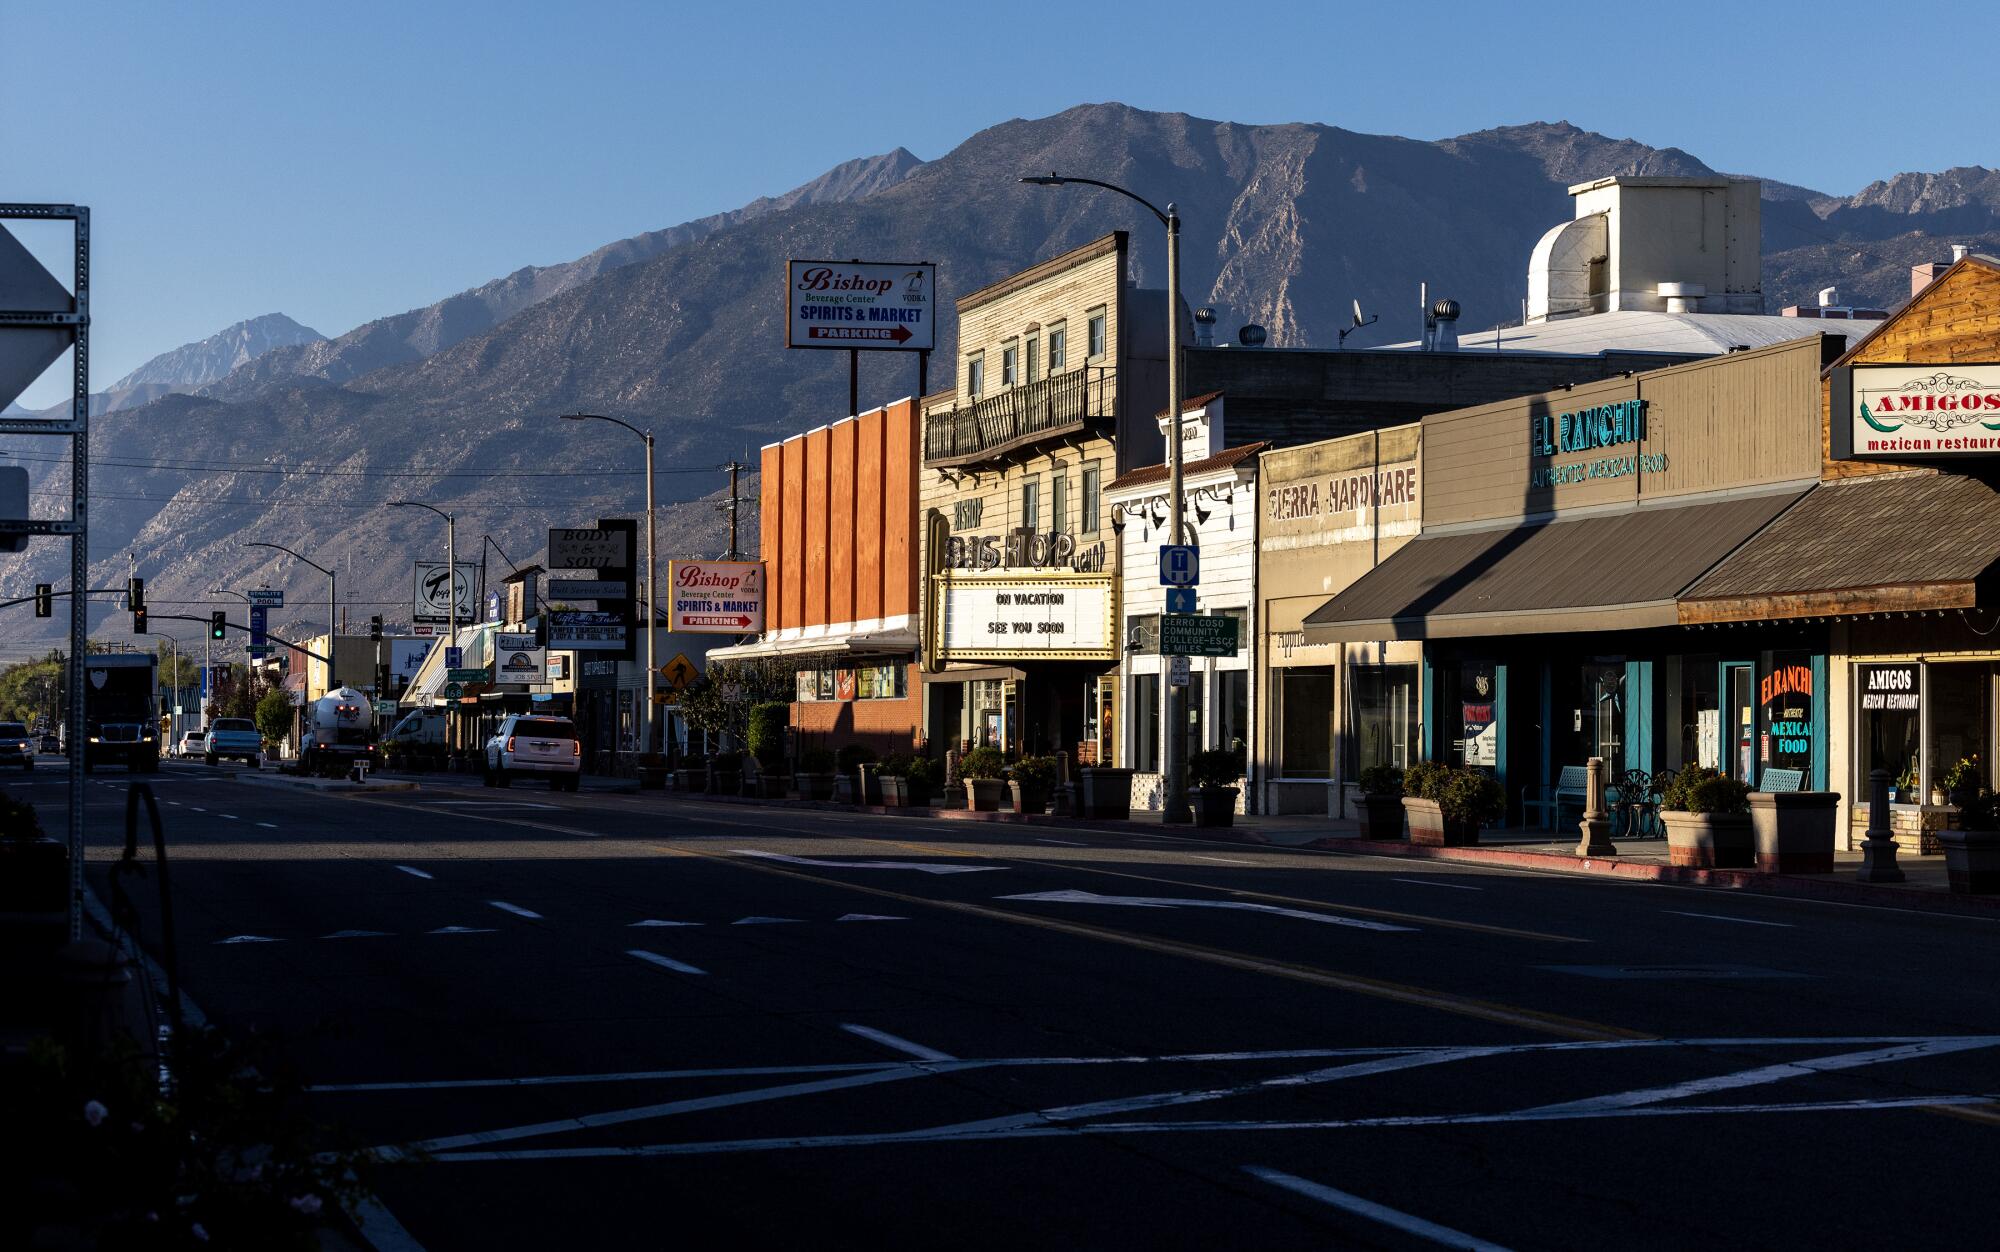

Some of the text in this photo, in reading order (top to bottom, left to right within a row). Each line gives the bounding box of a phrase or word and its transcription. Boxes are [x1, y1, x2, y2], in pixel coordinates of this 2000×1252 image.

[798, 268, 892, 296] Bishop
[806, 293, 876, 304] Beverage Center
[800, 306, 922, 322] SPIRITS & MARKET
[818, 328, 892, 339] PARKING
[1875, 394, 2000, 412] AMIGOS
[1534, 400, 1648, 456] EL RANCHIT
[1868, 437, 1931, 450] mexican
[1532, 453, 1670, 488] AUTHENTIC MEXICAN FOOD
[1269, 468, 1416, 520] SIERRA HARDWARE
[564, 530, 614, 540] BODY
[945, 534, 1076, 568] BISHOP
[565, 556, 614, 568] SOUL
[1175, 553, 1185, 568] T
[676, 566, 740, 589] Bishop
[426, 572, 464, 601] Toggry
[677, 600, 758, 612] SPIRITS & MARKET
[996, 593, 1064, 605] ON VACATION
[988, 622, 1064, 633] SEE YOU SOON
[1164, 618, 1224, 627] CERRO COSO
[1164, 627, 1219, 636] COMMUNITY
[1278, 632, 1328, 658] Applia
[448, 649, 459, 662] H
[1761, 664, 1812, 706] EL RANCHI
[1868, 670, 1912, 690] AMIGOS
[447, 689, 462, 697] 168
[380, 703, 387, 712] P
[1862, 694, 1919, 710] MEXICAN RESTAURANT
[1778, 739, 1807, 753] FOOD
